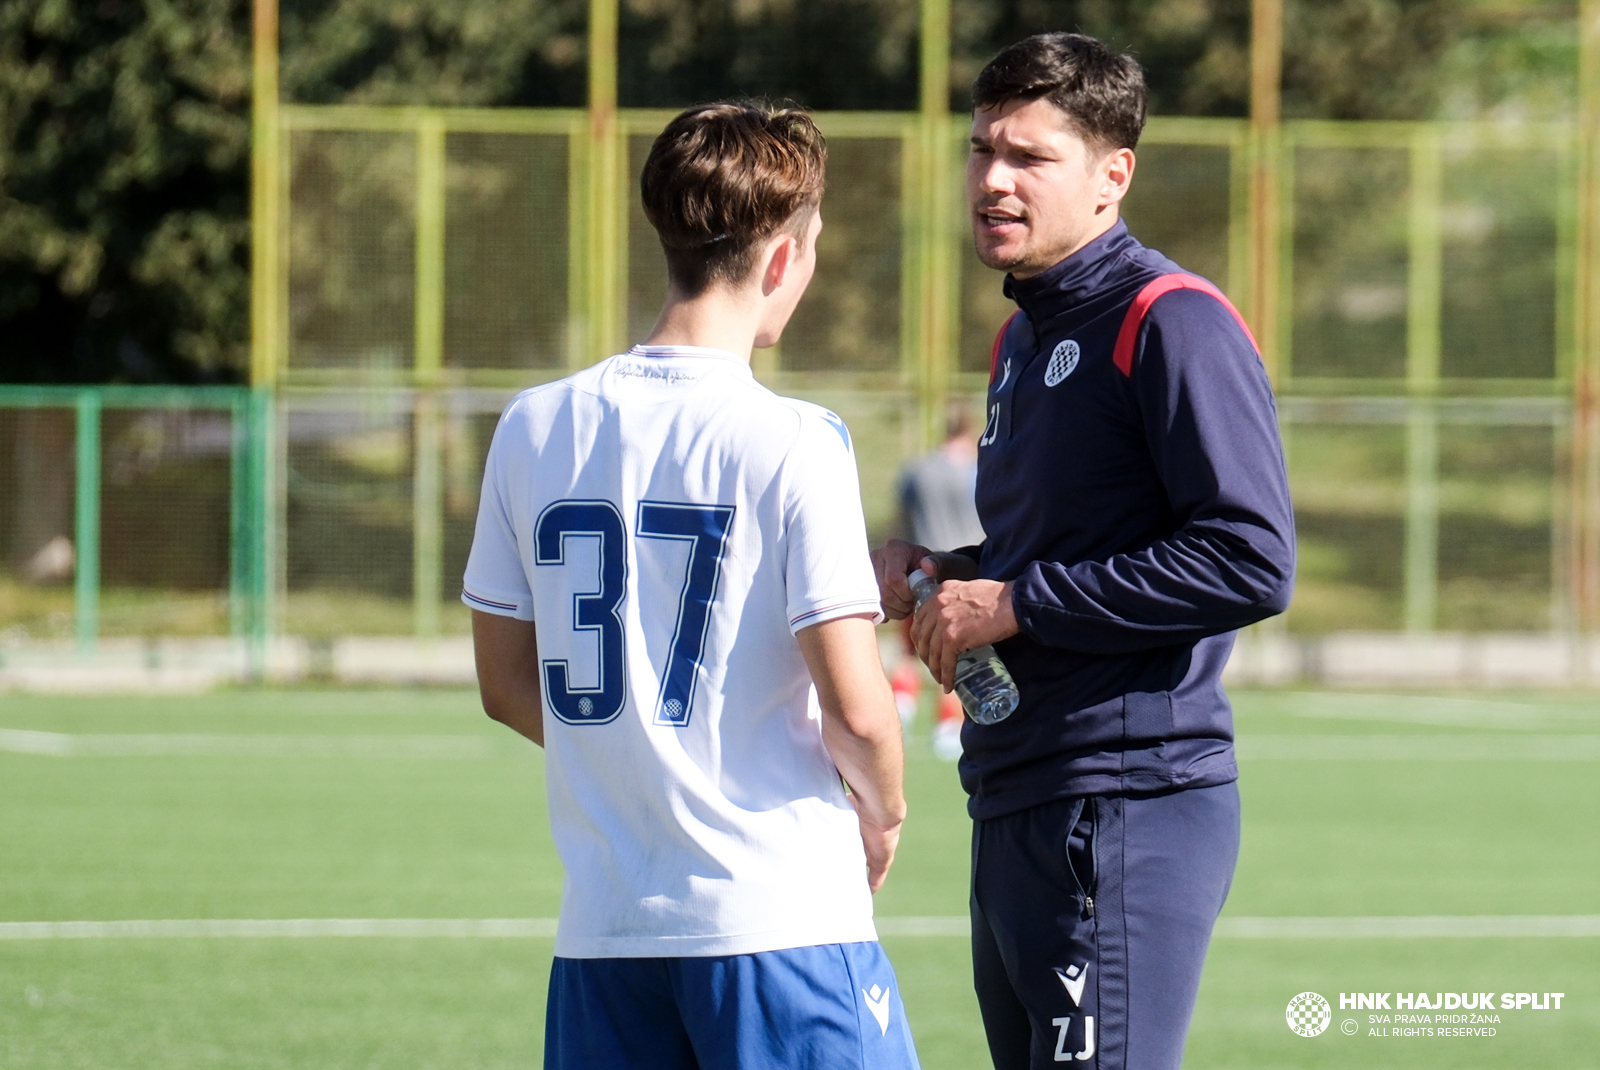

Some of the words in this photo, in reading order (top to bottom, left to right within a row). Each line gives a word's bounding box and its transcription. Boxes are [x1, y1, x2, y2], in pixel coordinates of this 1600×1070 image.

[980, 402, 1000, 447] ZJ
[534, 499, 736, 727] 37
[1052, 1015, 1096, 1062] ZJ
